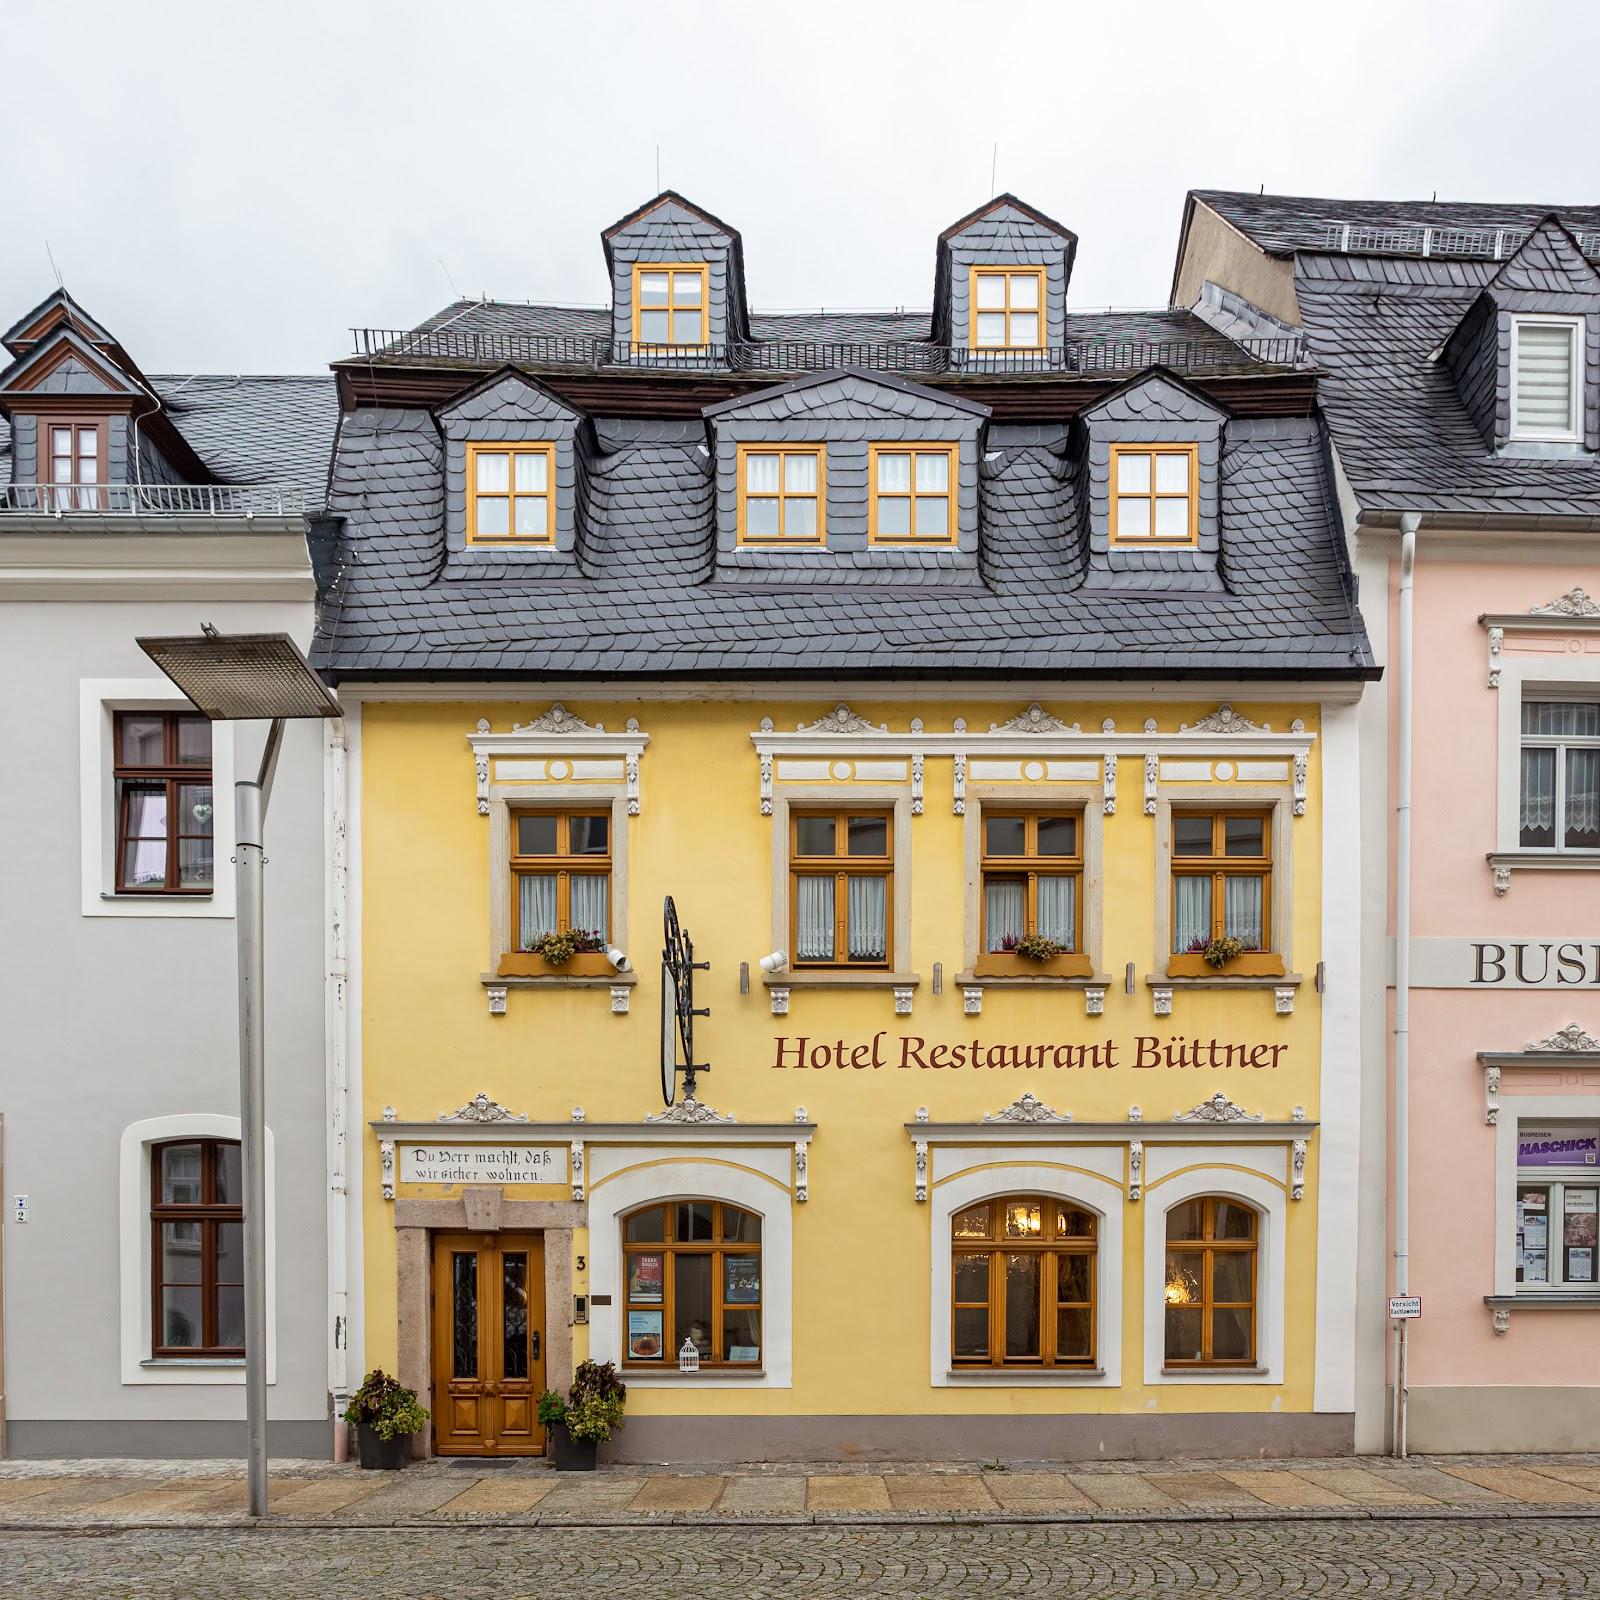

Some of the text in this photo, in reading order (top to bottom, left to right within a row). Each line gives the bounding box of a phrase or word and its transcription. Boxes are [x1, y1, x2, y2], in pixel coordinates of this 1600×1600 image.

[771, 1031, 1289, 1069] Hotel Restaurant Büttner
[1519, 1137, 1597, 1155] HASCHICK
[411, 1149, 435, 1162] Du
[439, 1150, 470, 1163] Herr
[525, 1149, 552, 1167] daß
[415, 1165, 543, 1181] wir sicher wohnen.
[17, 1211, 24, 1221] 2
[576, 1255, 586, 1270] 3
